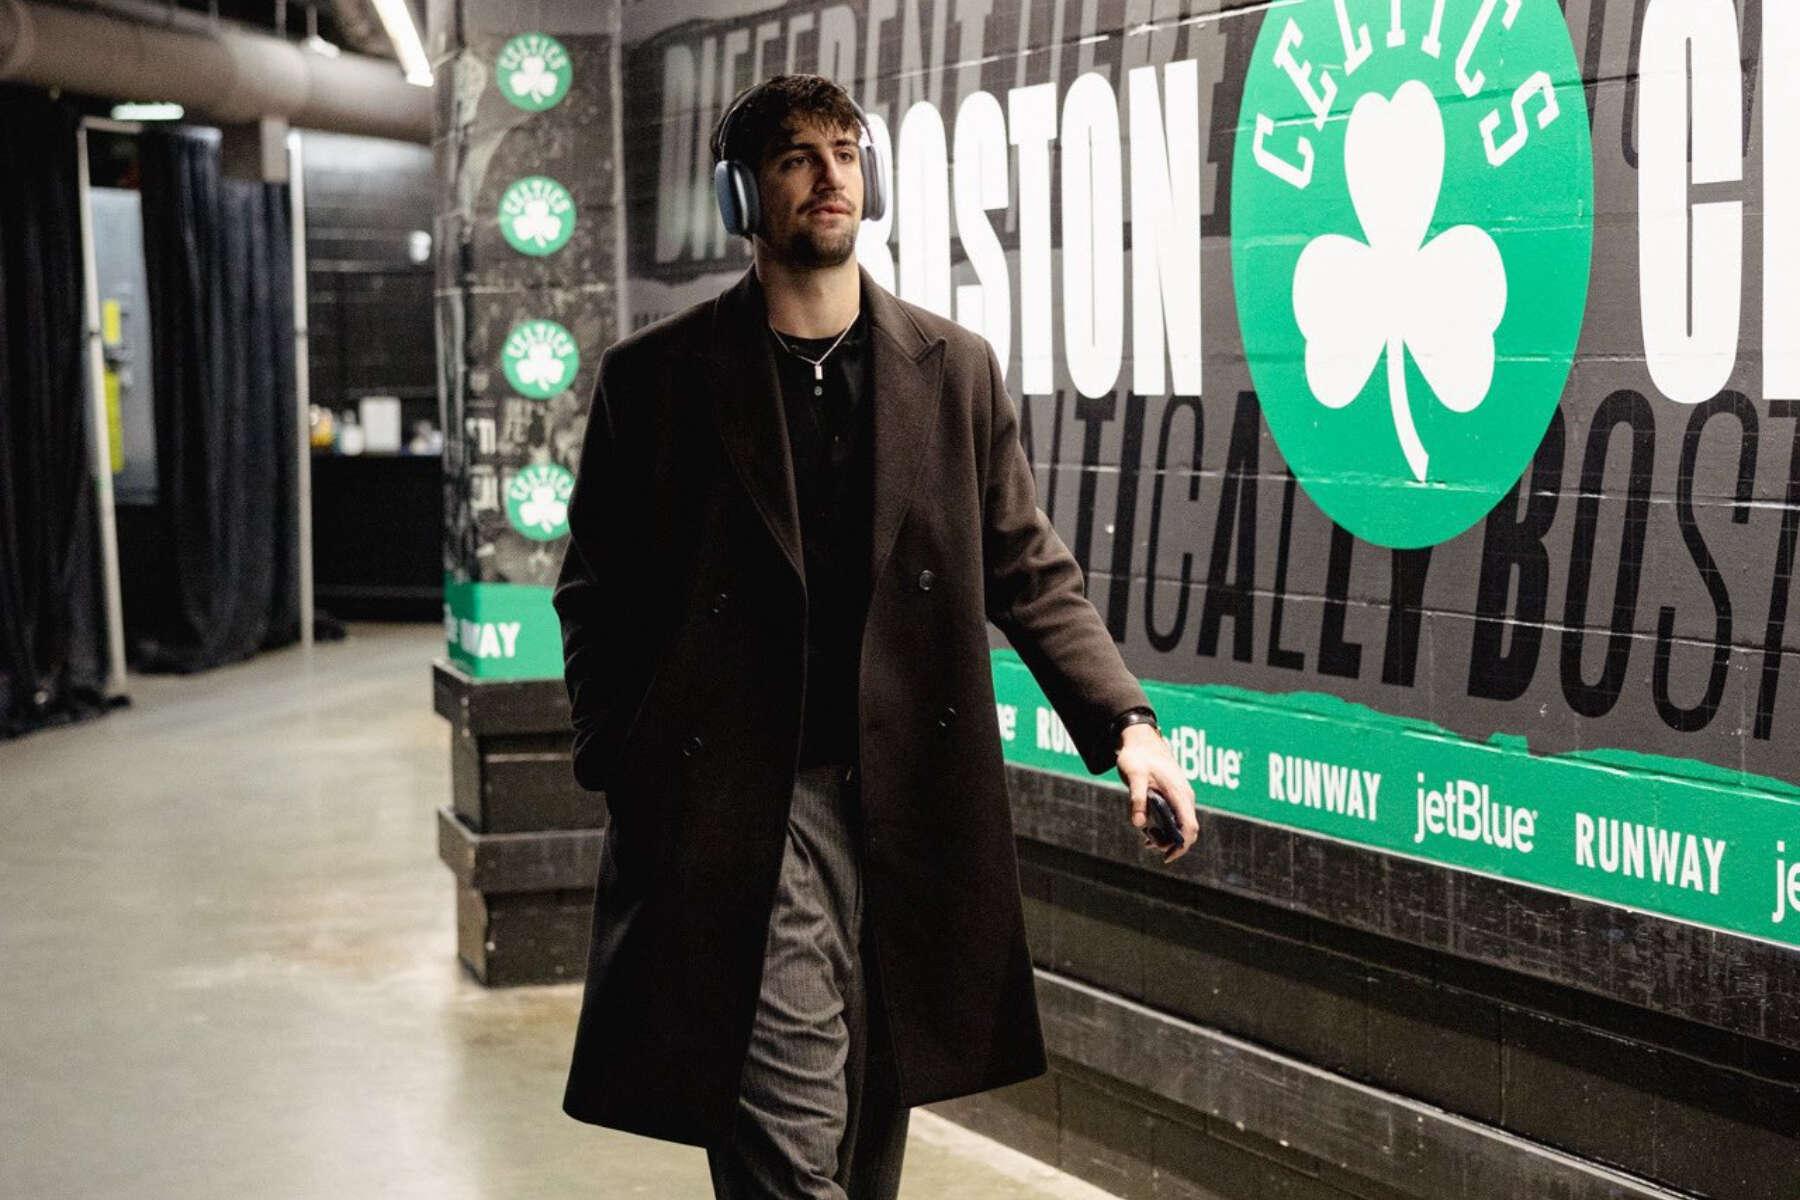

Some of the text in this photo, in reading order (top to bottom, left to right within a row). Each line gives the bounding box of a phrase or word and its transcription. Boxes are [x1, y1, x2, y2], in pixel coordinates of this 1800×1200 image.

[656, 0, 991, 263] DIFENT
[1161, 725, 1242, 790] tBlue
[1268, 752, 1381, 821] RUNWAY
[1413, 772, 1536, 853] jetBlue
[1575, 812, 1726, 895] RUNWAY
